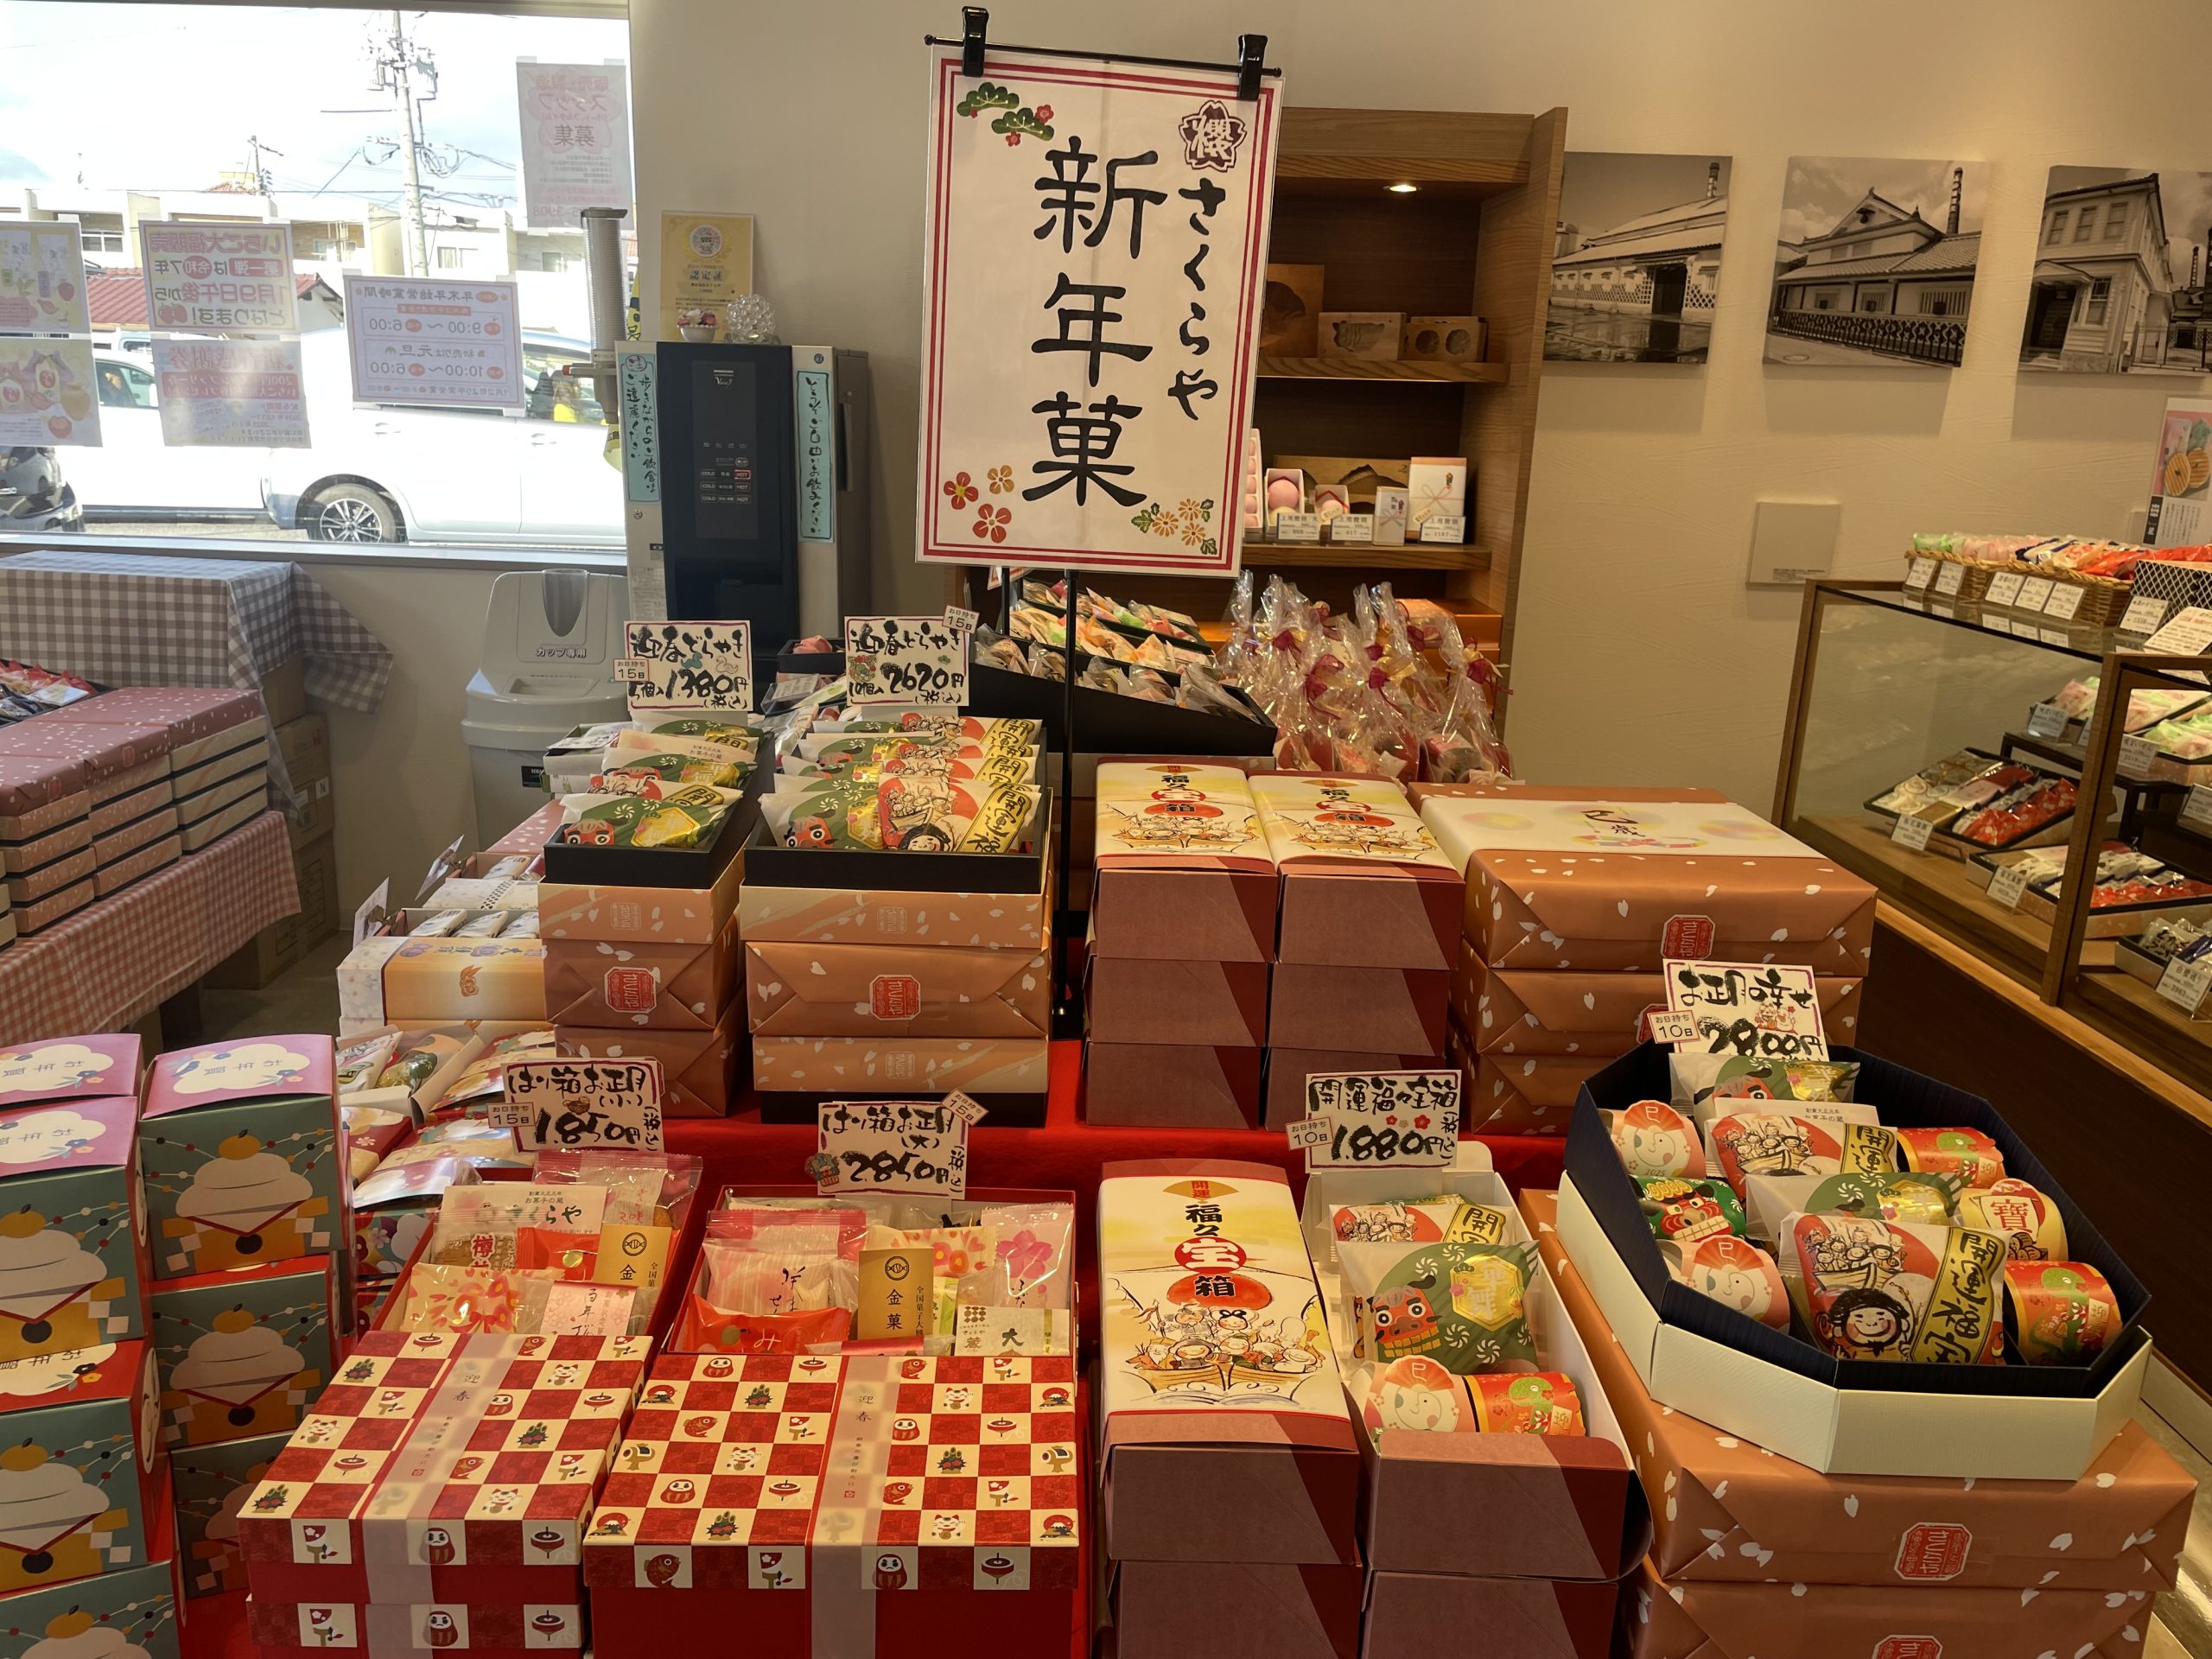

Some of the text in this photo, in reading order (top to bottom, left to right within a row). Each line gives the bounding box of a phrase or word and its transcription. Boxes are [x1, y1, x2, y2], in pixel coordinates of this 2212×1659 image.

[1167, 178, 1227, 421] さくらや
[1022, 136, 1167, 506] 新年菓
[949, 607, 976, 620] お日持ち
[948, 616, 973, 631] 15日
[630, 625, 743, 663] 迎春どらやき
[850, 620, 960, 656] 迎春どらやき
[535, 647, 588, 658] カップ専用
[618, 669, 645, 679] 15日
[1656, 1014, 1689, 1024] お日持ち
[1658, 1024, 1694, 1039] 10日
[953, 1091, 985, 1115] お日持ち
[1309, 1076, 1457, 1113] 開運福々宝箱
[492, 1105, 530, 1114] お日持ち
[949, 1097, 976, 1122] 15日
[493, 1114, 530, 1125] 15日
[1290, 1121, 1326, 1133] お日持ち
[900, 1135, 940, 1150] (大)
[1293, 1132, 1328, 1145] 10日
[1644, 1167, 1666, 1177] 2025
[1189, 1179, 1211, 1199] 開運
[1179, 1203, 1242, 1297] 福々宝箱
[619, 1263, 637, 1281] 金
[886, 1288, 904, 1331] 金菓
[454, 1374, 481, 1402] 迎春
[855, 1394, 874, 1422] 迎春
